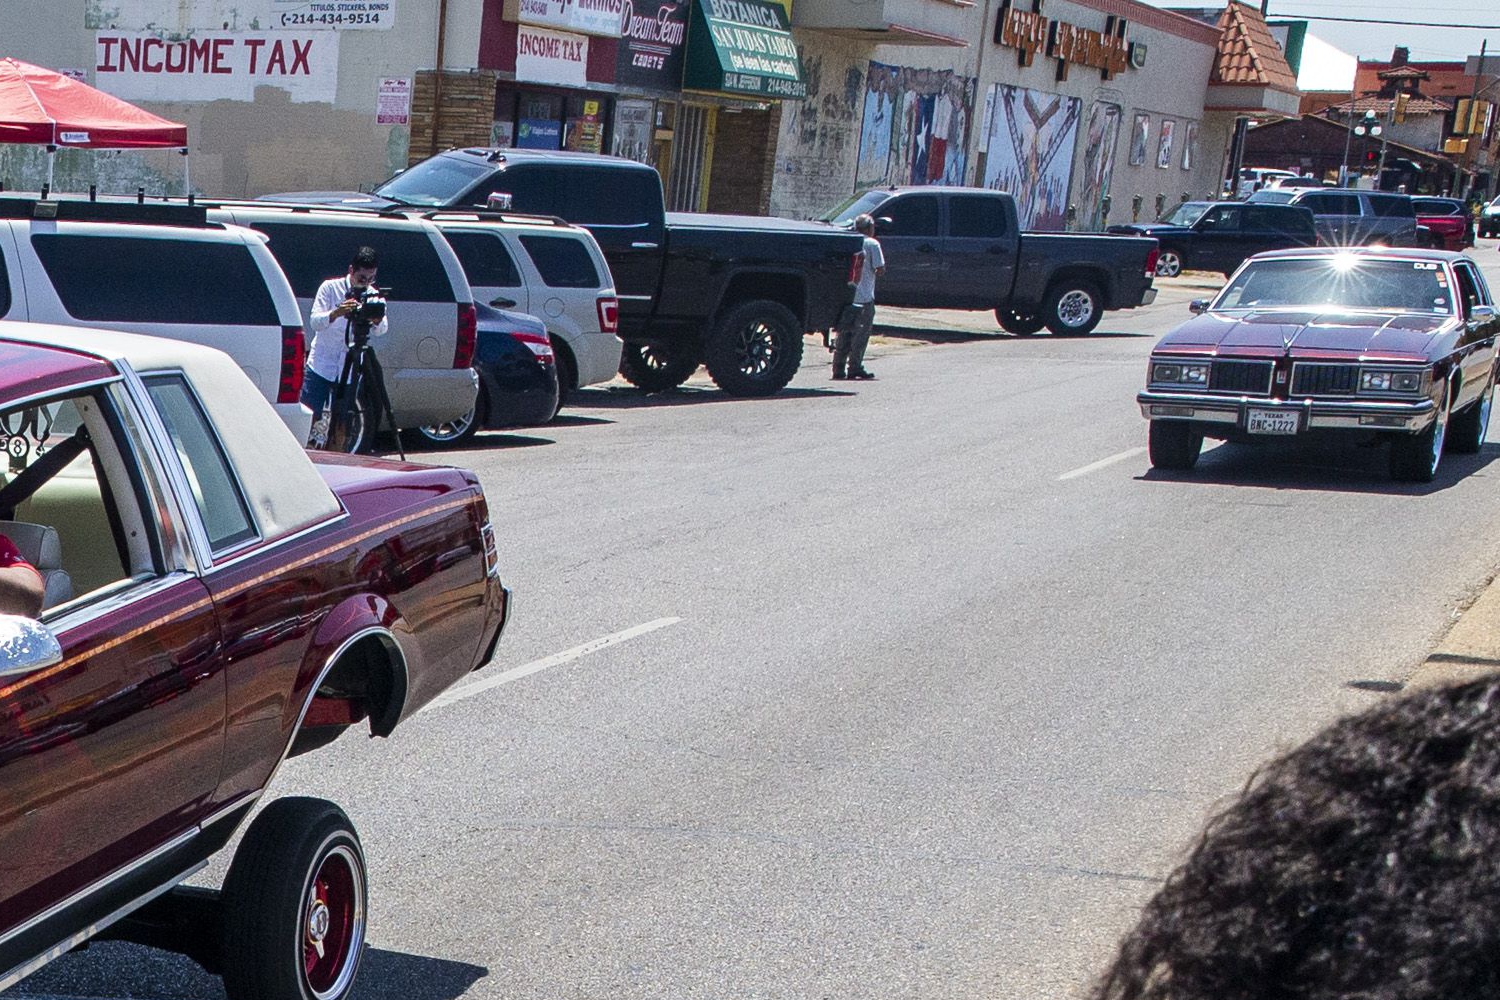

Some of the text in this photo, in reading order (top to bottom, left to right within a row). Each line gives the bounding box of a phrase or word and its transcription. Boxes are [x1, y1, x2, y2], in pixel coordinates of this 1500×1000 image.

[622, 0, 684, 45] Dream Team
[710, 0, 782, 29] BOTANICA
[97, 37, 314, 76] INCOME TAX
[520, 33, 583, 62] INCOME TAX
